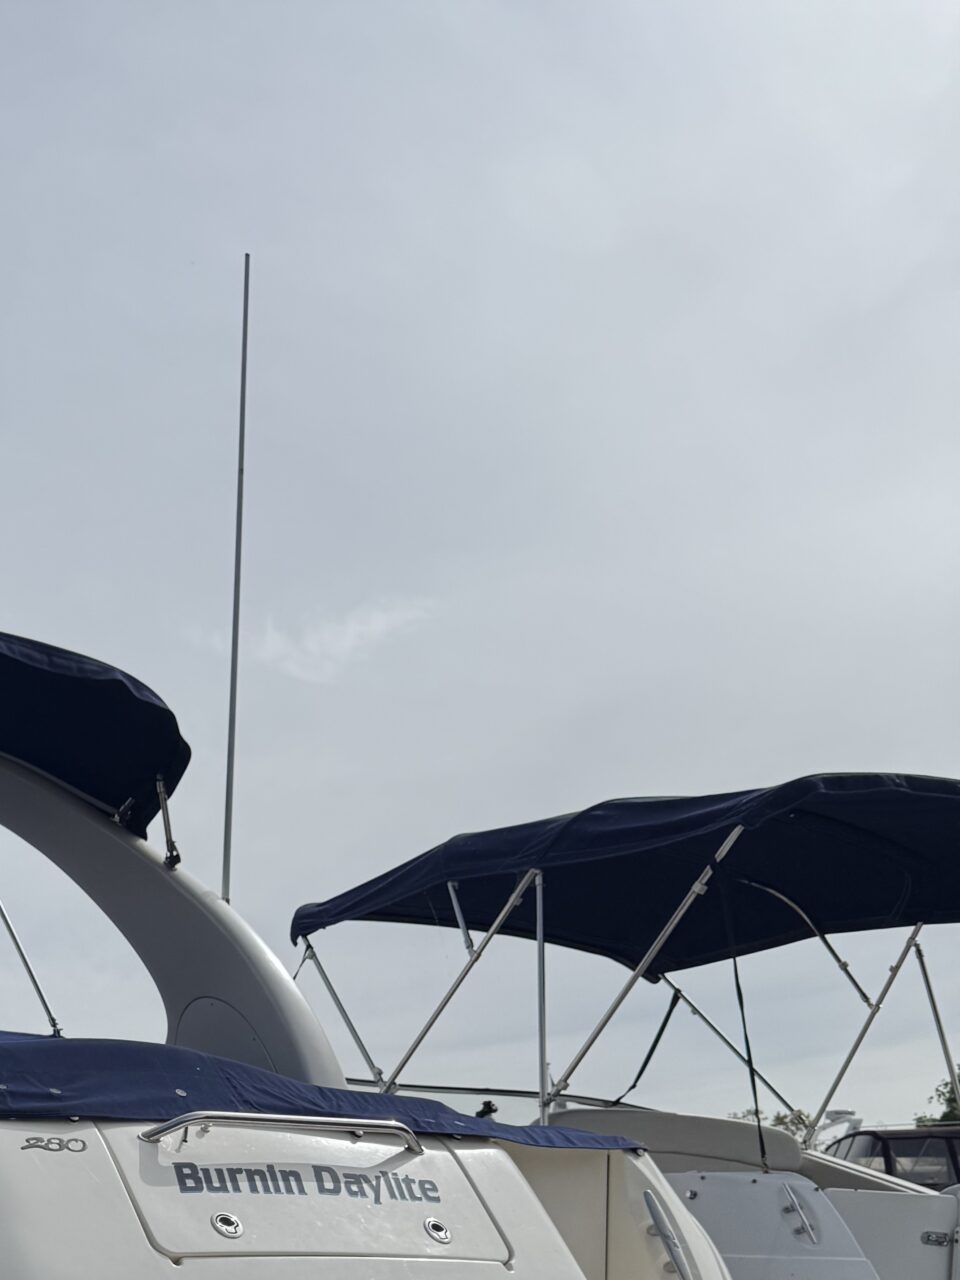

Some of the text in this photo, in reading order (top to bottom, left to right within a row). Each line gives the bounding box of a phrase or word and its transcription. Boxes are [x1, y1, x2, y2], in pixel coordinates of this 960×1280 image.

[20, 1137, 87, 1153] 280
[172, 1162, 441, 1204] Burnin Daylite
